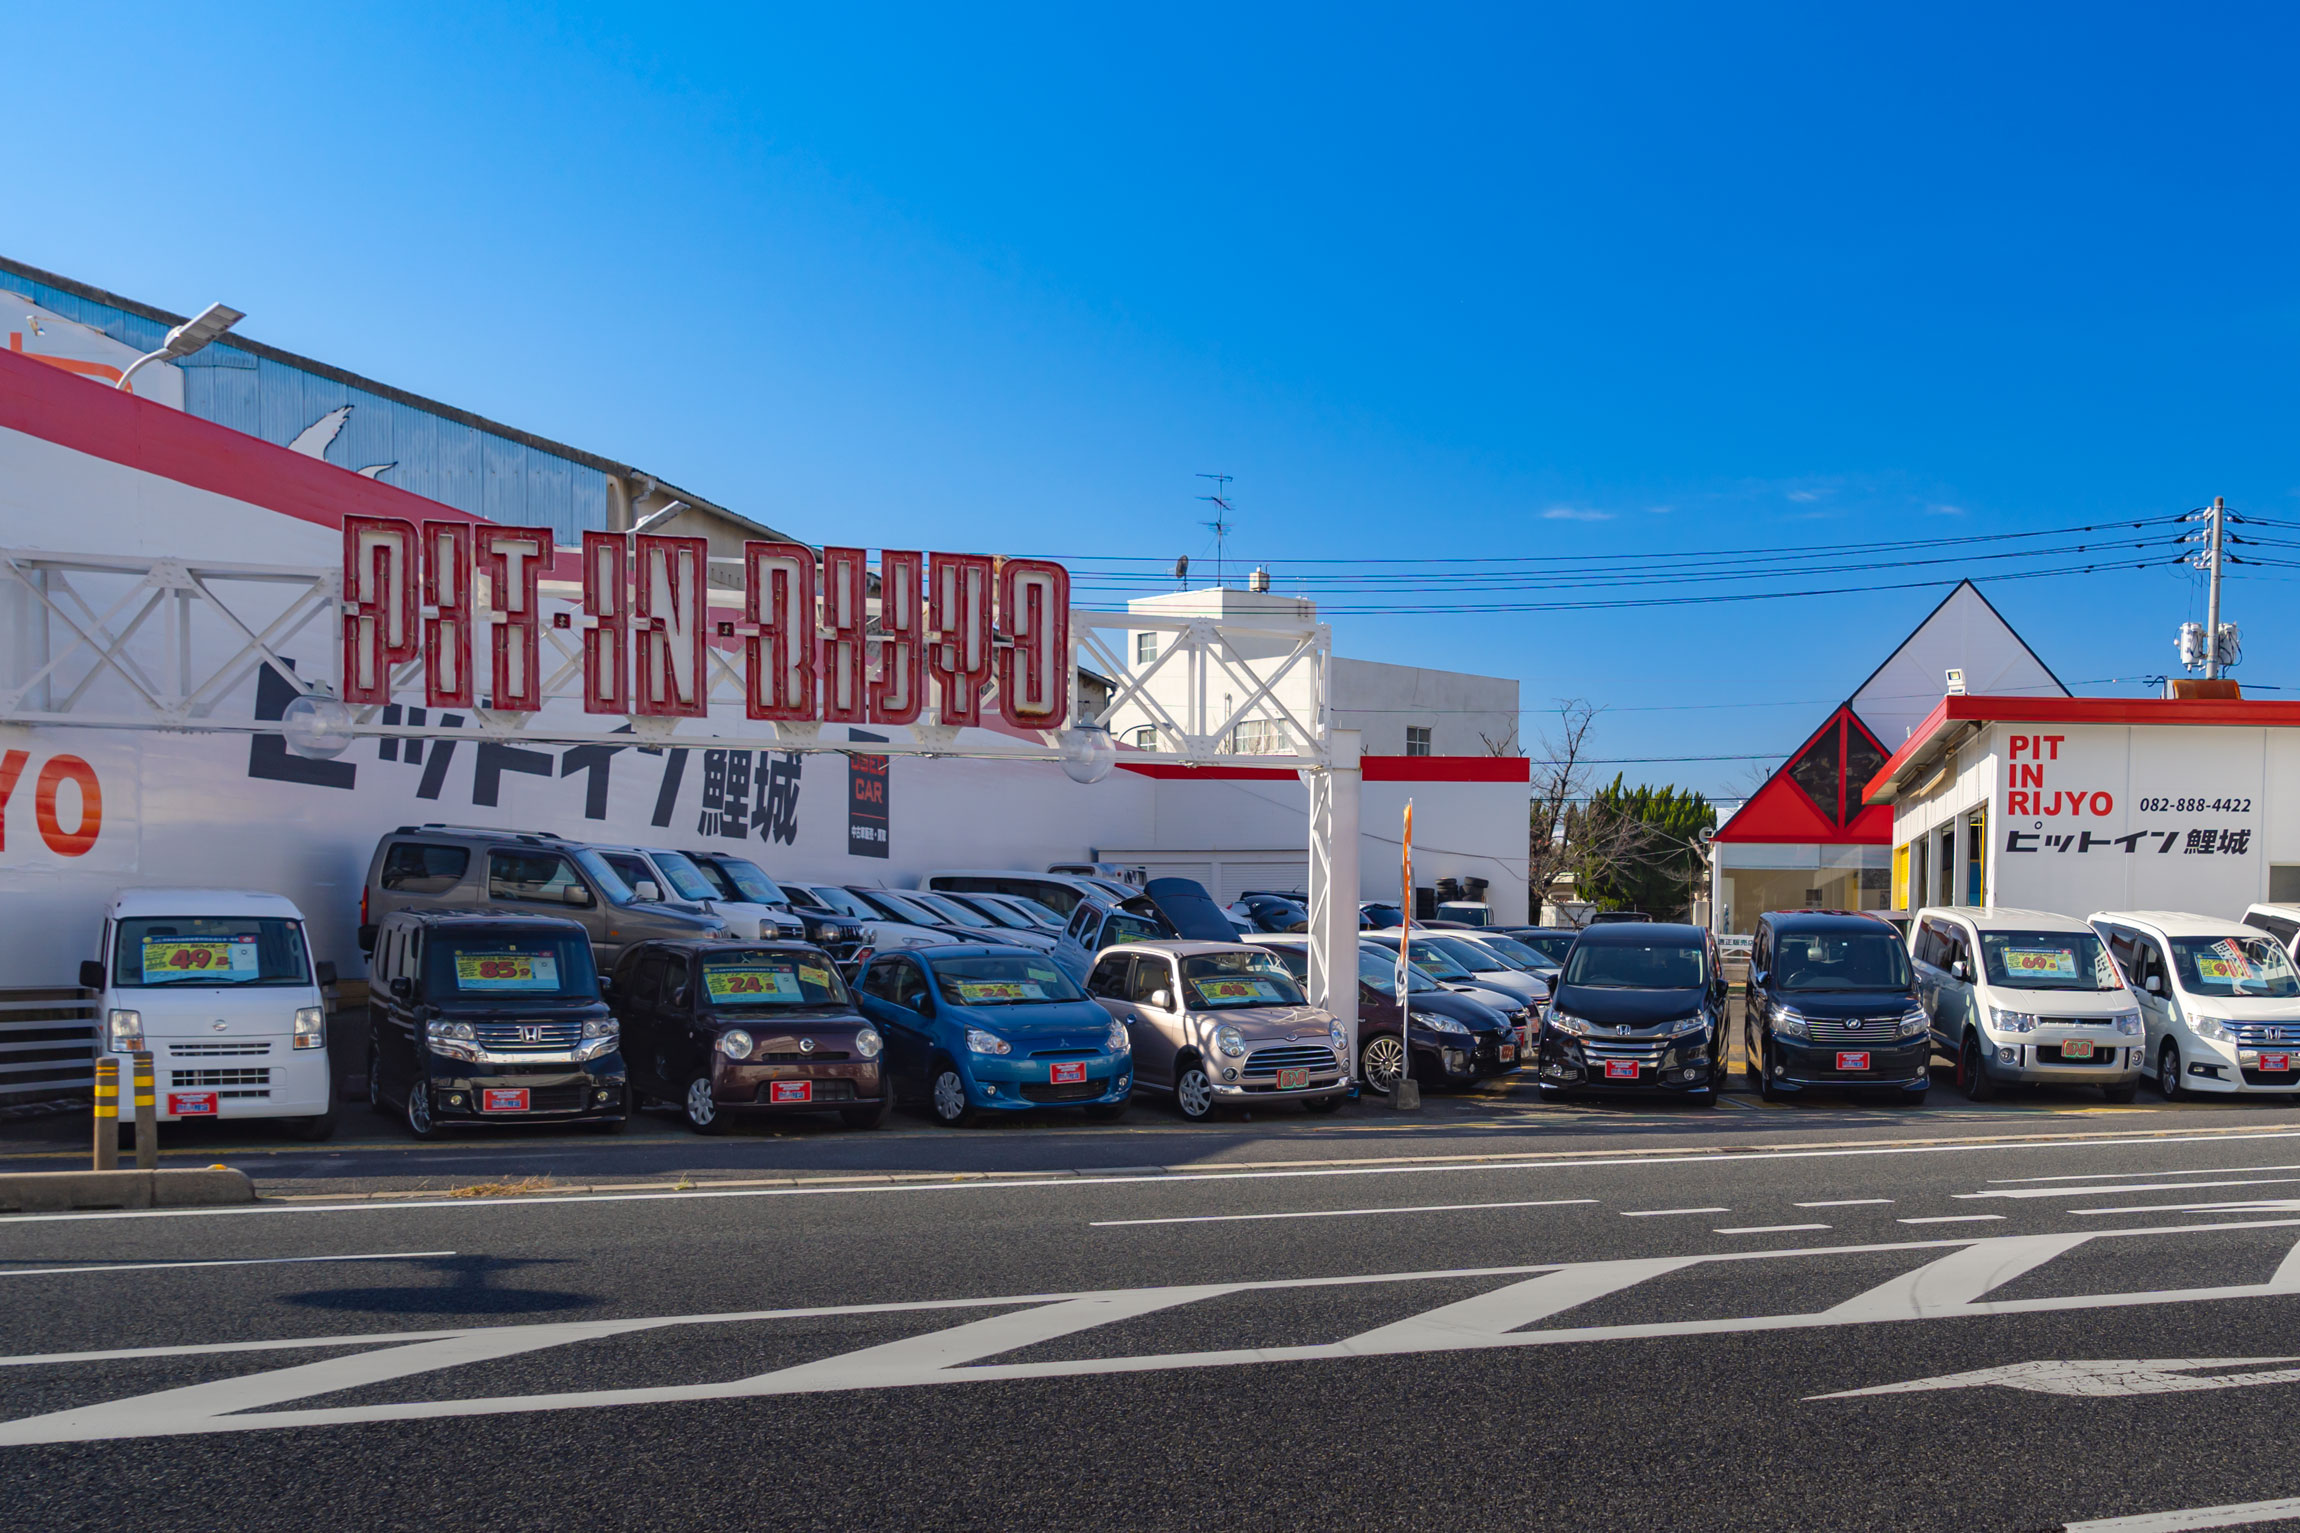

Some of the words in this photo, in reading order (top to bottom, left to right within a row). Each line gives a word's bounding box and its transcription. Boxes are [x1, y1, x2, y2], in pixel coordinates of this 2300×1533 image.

[2009, 735, 2065, 760] PIT
[851, 752, 888, 776] USED
[2009, 764, 2044, 788] IN
[855, 777, 883, 804] CAR
[2008, 791, 2113, 816] RIJYO
[2140, 798, 2251, 812] 082-888-4422
[480, 961, 516, 979] 85
[2022, 956, 2047, 970] 69
